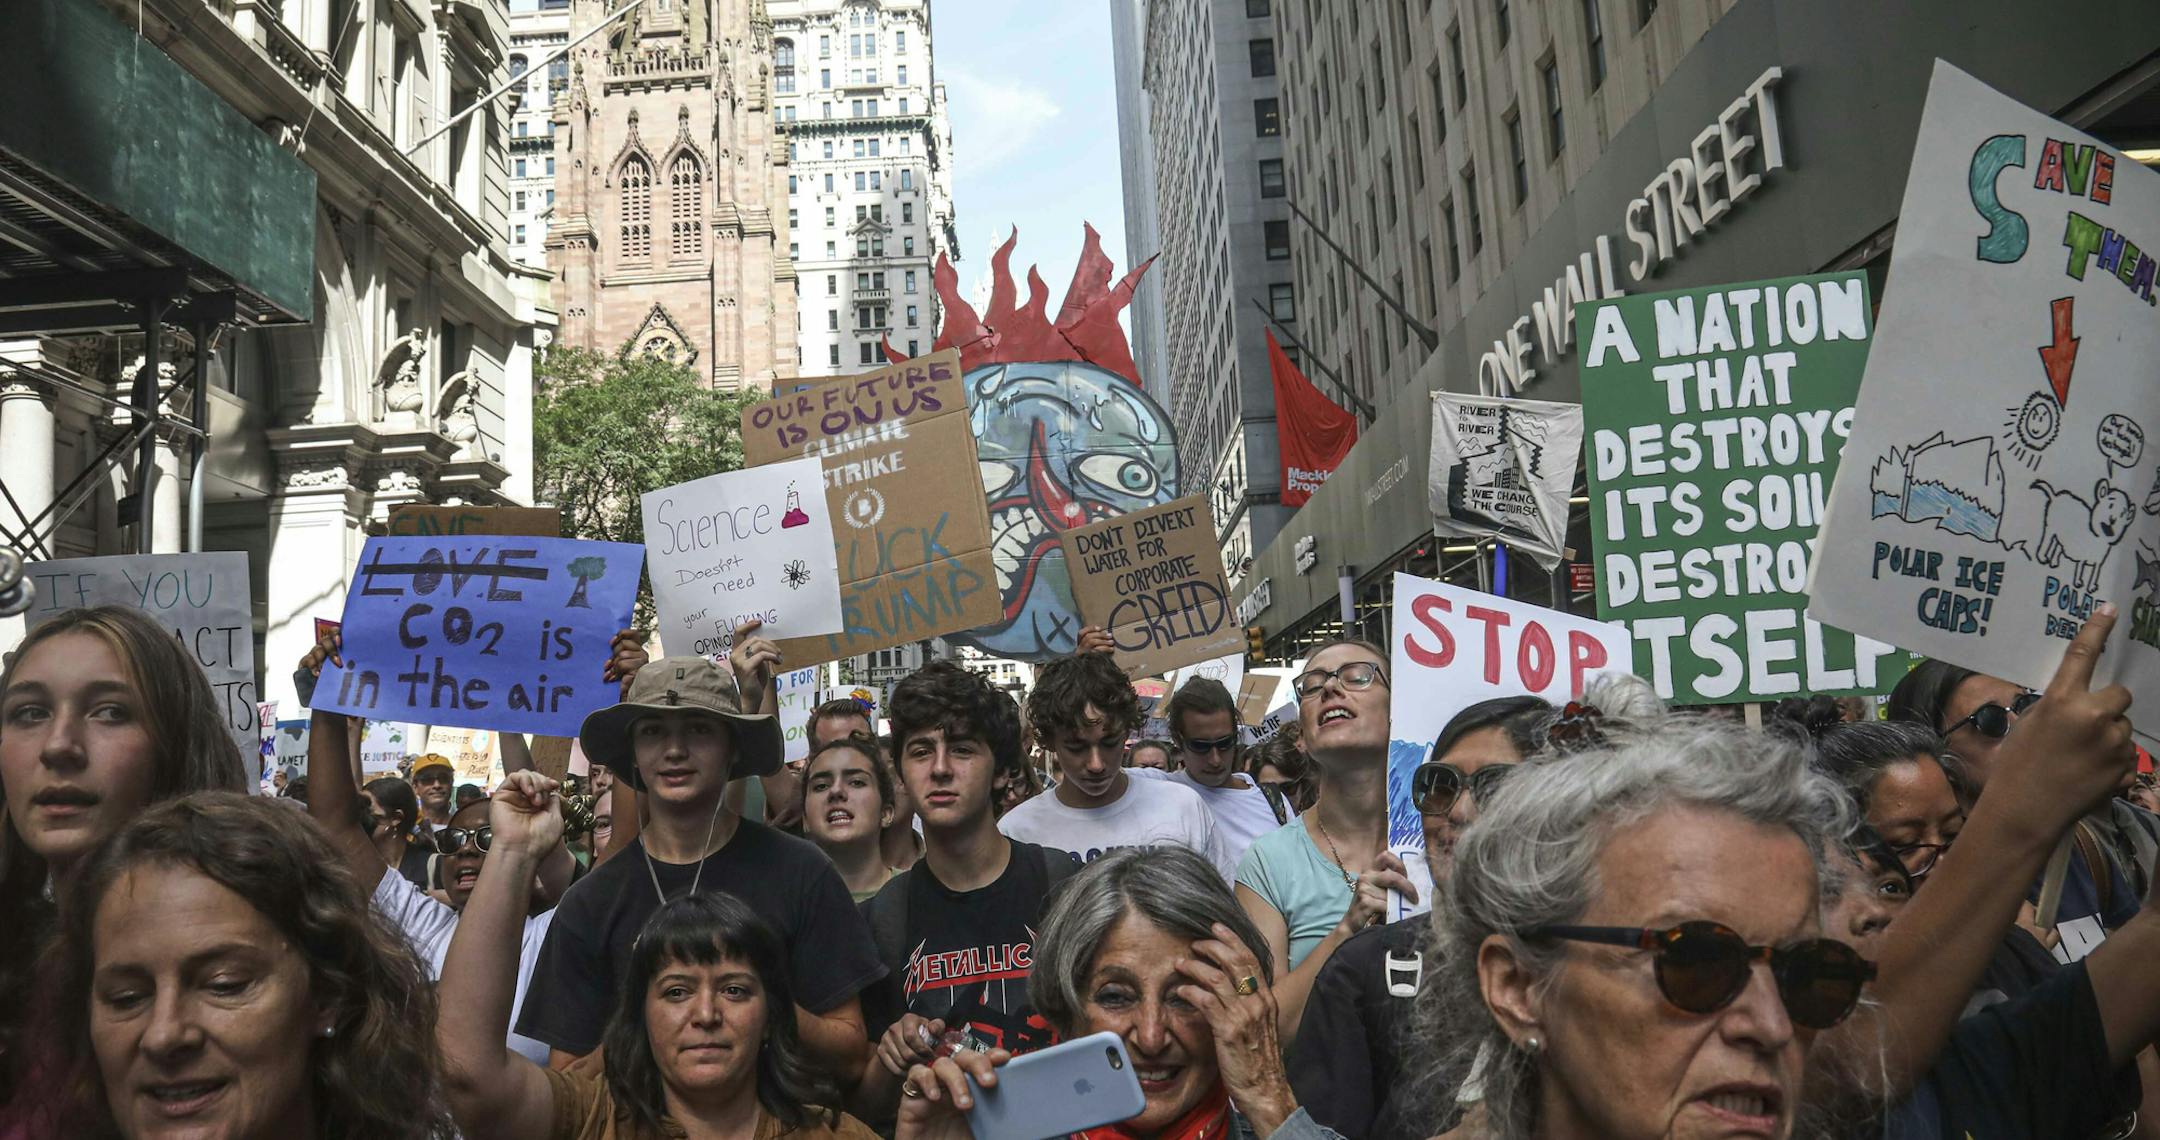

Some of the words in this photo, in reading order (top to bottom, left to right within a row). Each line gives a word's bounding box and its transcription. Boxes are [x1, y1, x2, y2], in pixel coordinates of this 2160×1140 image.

[1969, 134, 2116, 264] SAVE
[1480, 315, 1536, 394] ONE
[1532, 235, 1625, 364] WALL
[1626, 66, 1783, 281] STREET
[1586, 304, 1641, 368] A
[1654, 279, 1867, 358] NATION
[752, 397, 814, 429] OUR
[823, 362, 953, 410] FUTURE
[1652, 351, 1797, 415] THAT
[777, 423, 808, 449] IS
[820, 400, 883, 436] ON
[892, 387, 942, 417] US
[803, 418, 910, 458] CLIMATE
[1458, 423, 1494, 435] RIVER
[1459, 405, 1496, 417] RIVER
[823, 451, 906, 490] STRIKE
[1471, 489, 1494, 500] WE
[1497, 491, 1537, 505] CHANG
[657, 498, 772, 556] Science
[1076, 526, 1124, 555] DON'T
[1133, 506, 1196, 540] DIVERT
[1473, 500, 1492, 511] THE
[1494, 504, 1539, 517] COURSE
[1605, 481, 1704, 541] ITS
[1722, 472, 1825, 533] SOIL
[361, 546, 540, 601] LOVE
[836, 511, 961, 591] UCK
[1084, 548, 1132, 575] WATER
[1137, 537, 1168, 561] FOR
[1115, 554, 1200, 596] CORPORATE
[1605, 540, 1818, 608] DESTRO
[1872, 541, 1943, 580] POLAR
[1955, 556, 2005, 596] ICE
[36, 573, 97, 611] IF
[122, 568, 212, 609] YOU
[713, 571, 755, 594] need
[399, 603, 504, 655] CO2
[540, 620, 573, 660] is
[683, 608, 708, 630] your
[1108, 573, 1236, 652] GREED!
[1917, 587, 1993, 637] CAPS!
[694, 634, 734, 655] OPINIO
[1404, 594, 1608, 700] STOP
[1608, 608, 1896, 699] TSELF
[337, 659, 380, 708] in
[398, 655, 490, 709] the
[508, 674, 573, 712] air
[790, 669, 814, 688] FOR
[277, 755, 306, 767] LANET
[372, 752, 404, 762] JUSTIC
[903, 930, 1041, 1005] METALLIC
